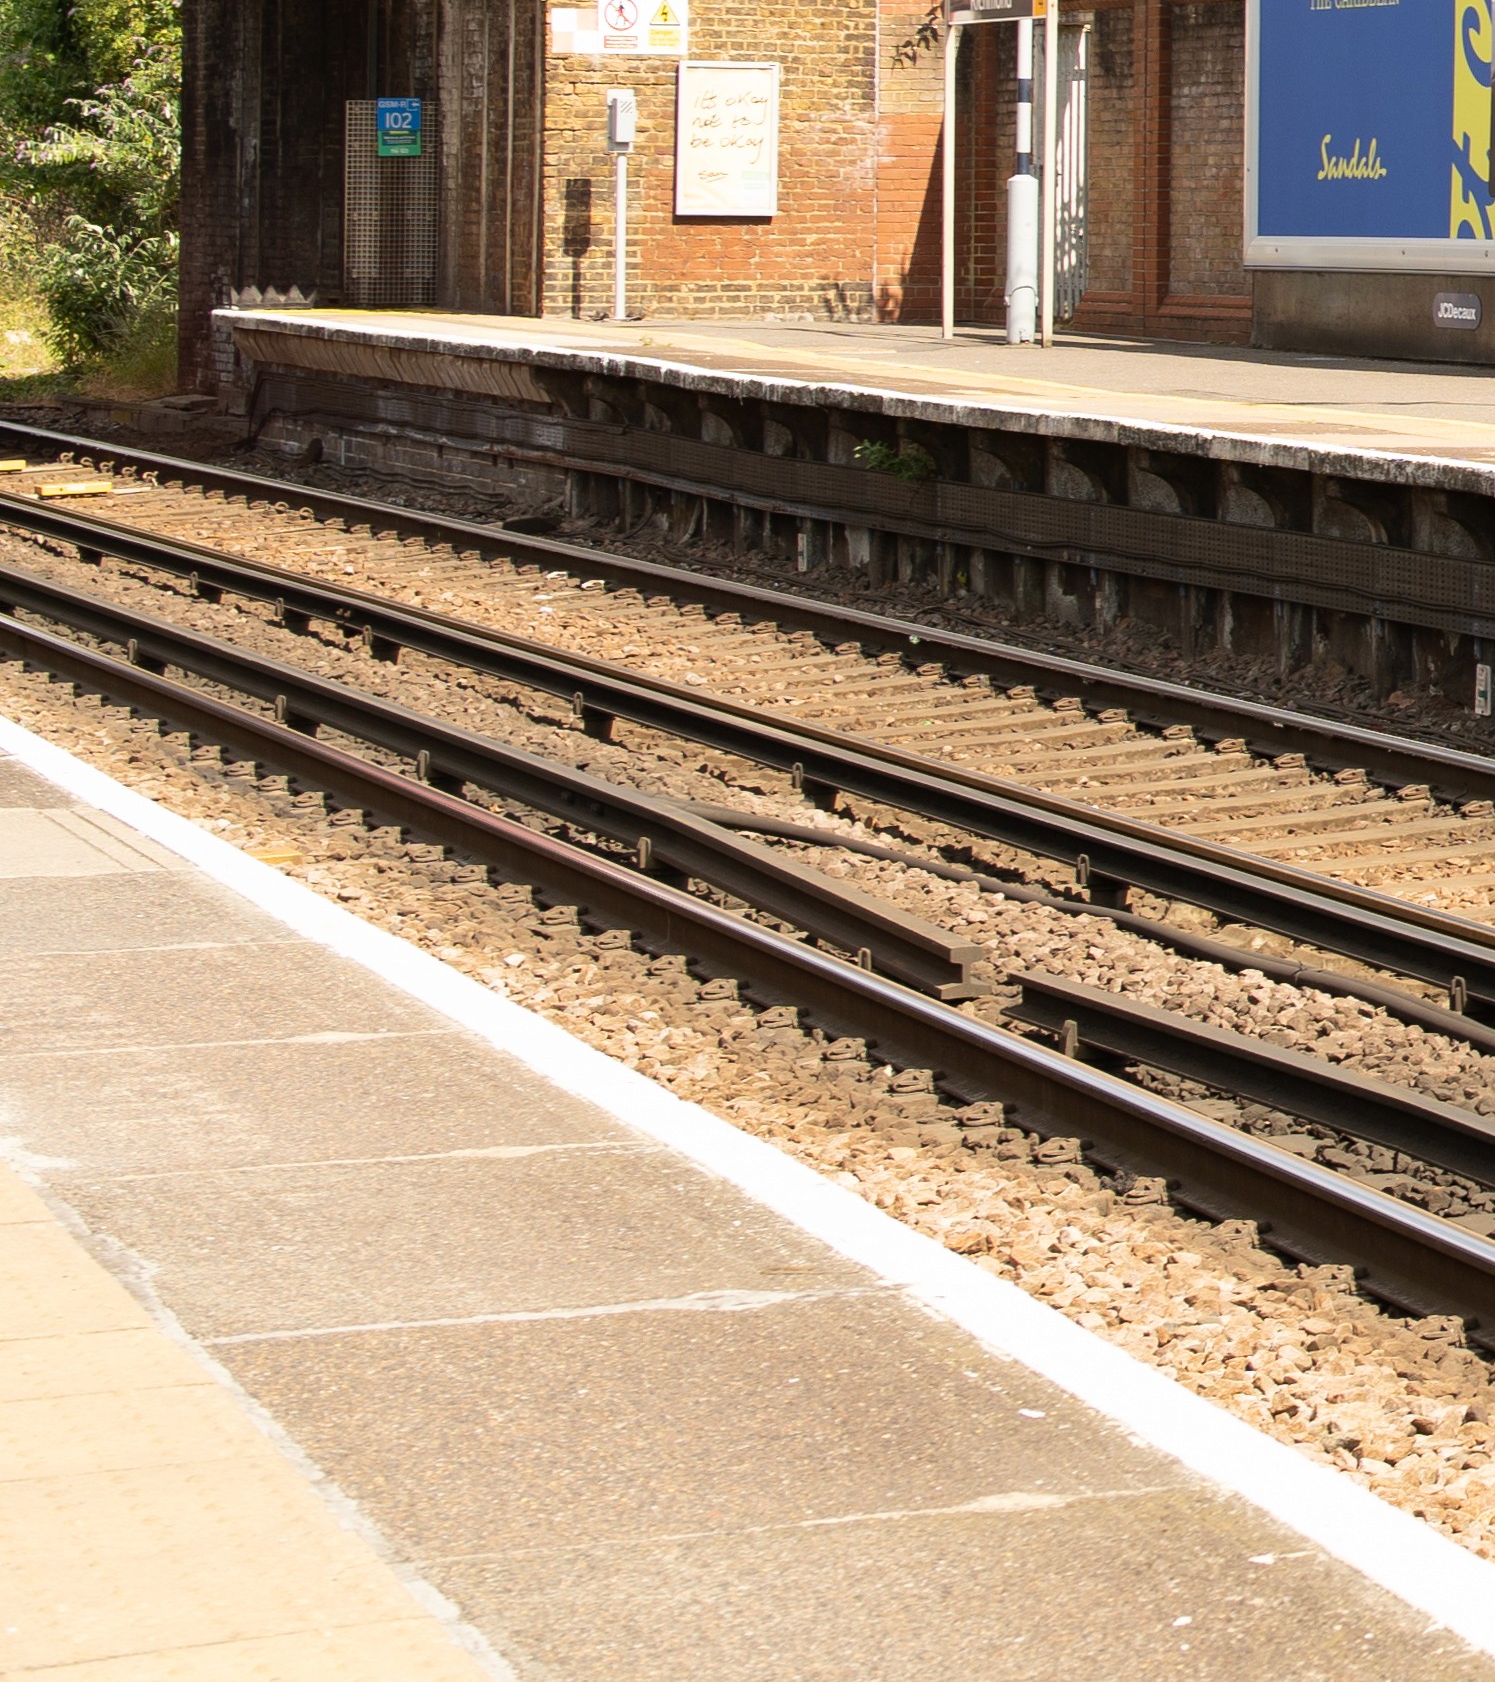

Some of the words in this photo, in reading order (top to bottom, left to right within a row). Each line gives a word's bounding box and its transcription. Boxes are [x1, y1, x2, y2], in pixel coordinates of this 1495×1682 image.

[385, 112, 412, 128] 102
[692, 114, 722, 129] not
[689, 134, 714, 149] be
[1317, 133, 1387, 180] Sandals
[1437, 302, 1477, 320] JCDecaux
